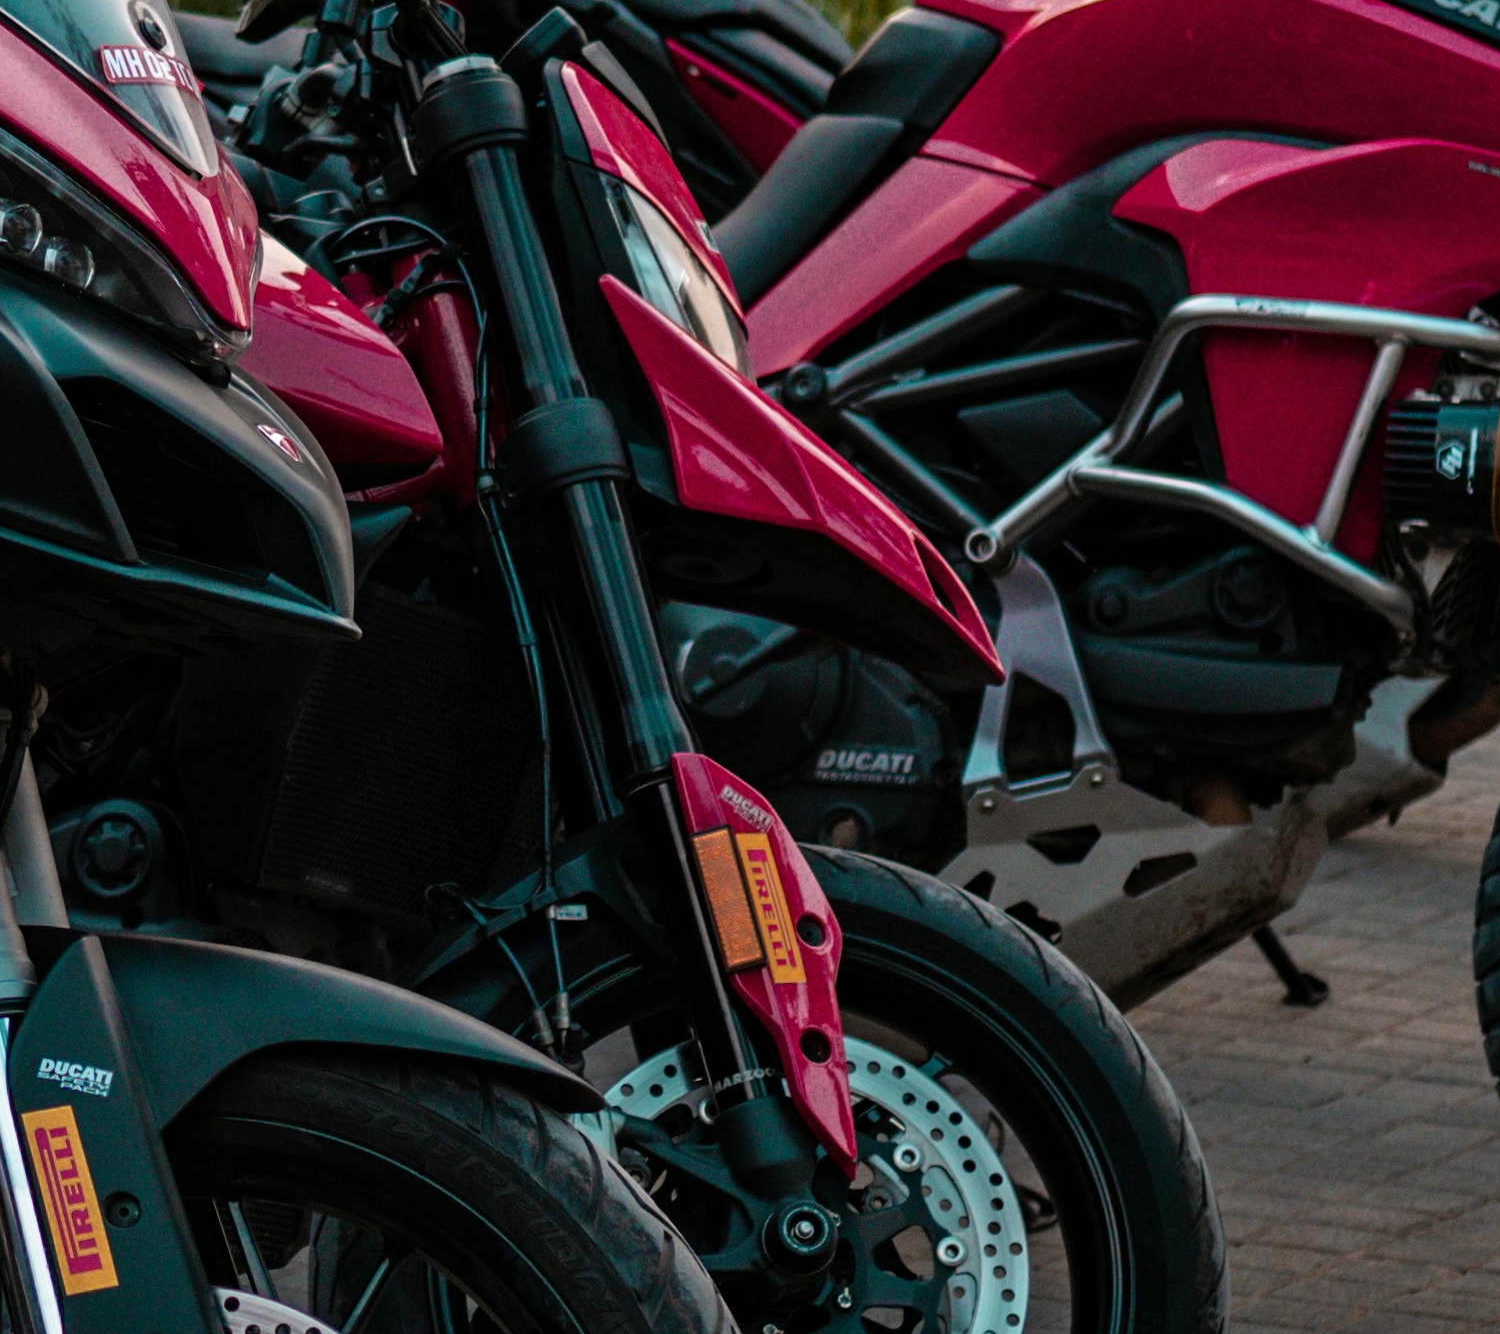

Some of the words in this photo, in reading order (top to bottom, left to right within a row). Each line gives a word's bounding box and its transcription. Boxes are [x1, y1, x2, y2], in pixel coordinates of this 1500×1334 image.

[103, 49, 147, 79] MH
[143, 50, 176, 82] 02
[817, 749, 915, 774] DUCATI
[721, 786, 774, 827] DUCATI
[747, 849, 797, 968] PIRELLI
[39, 1058, 113, 1085] DUCATI
[60, 1081, 109, 1098] PACK
[35, 1127, 102, 1275] PIRELLI
